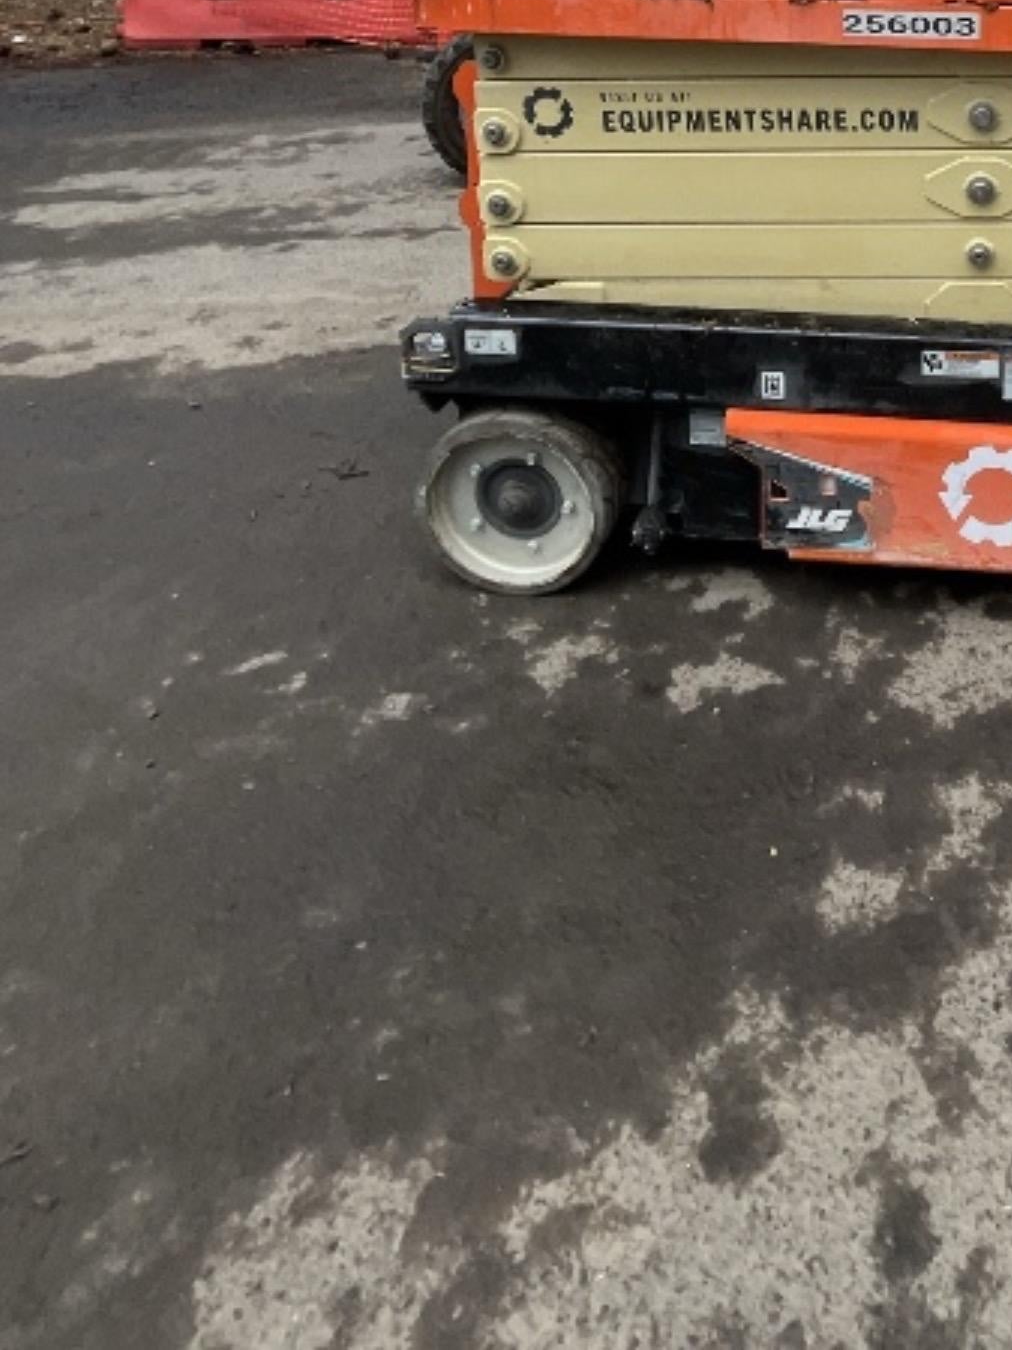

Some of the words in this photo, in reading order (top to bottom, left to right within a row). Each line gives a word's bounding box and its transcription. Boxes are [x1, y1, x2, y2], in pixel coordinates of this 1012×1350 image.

[843, 14, 976, 36] 256003
[601, 109, 919, 133] EQUIPMENTSHARE.COM
[785, 505, 853, 532] JLG
